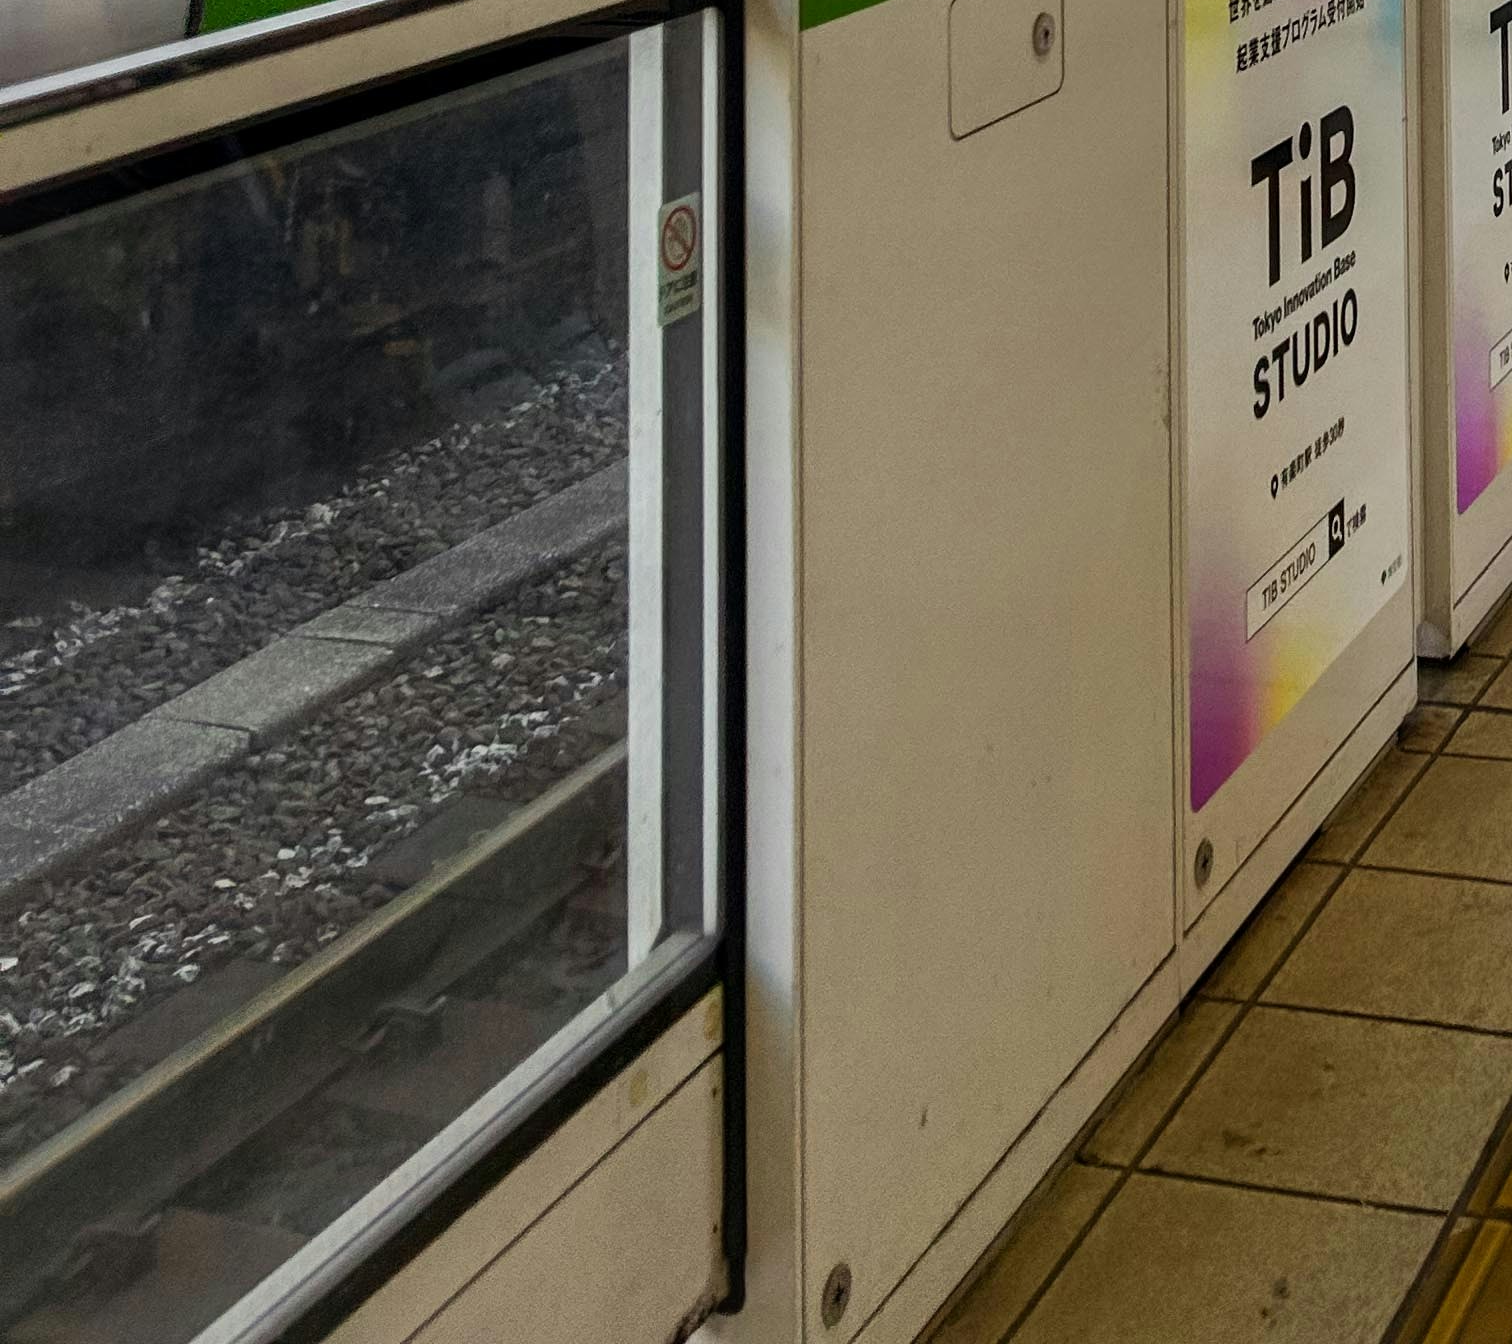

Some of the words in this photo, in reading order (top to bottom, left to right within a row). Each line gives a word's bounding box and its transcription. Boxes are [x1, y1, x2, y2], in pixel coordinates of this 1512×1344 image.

[1492, 127, 1511, 156] Tokyo
[1251, 105, 1356, 288] TiB
[1252, 305, 1282, 342] Tokyo
[1283, 267, 1332, 320] Innovation
[1334, 249, 1356, 282] Base
[1253, 287, 1358, 419] STUDIO
[1262, 579, 1278, 612] TIB
[1280, 542, 1316, 594] STUDIO
